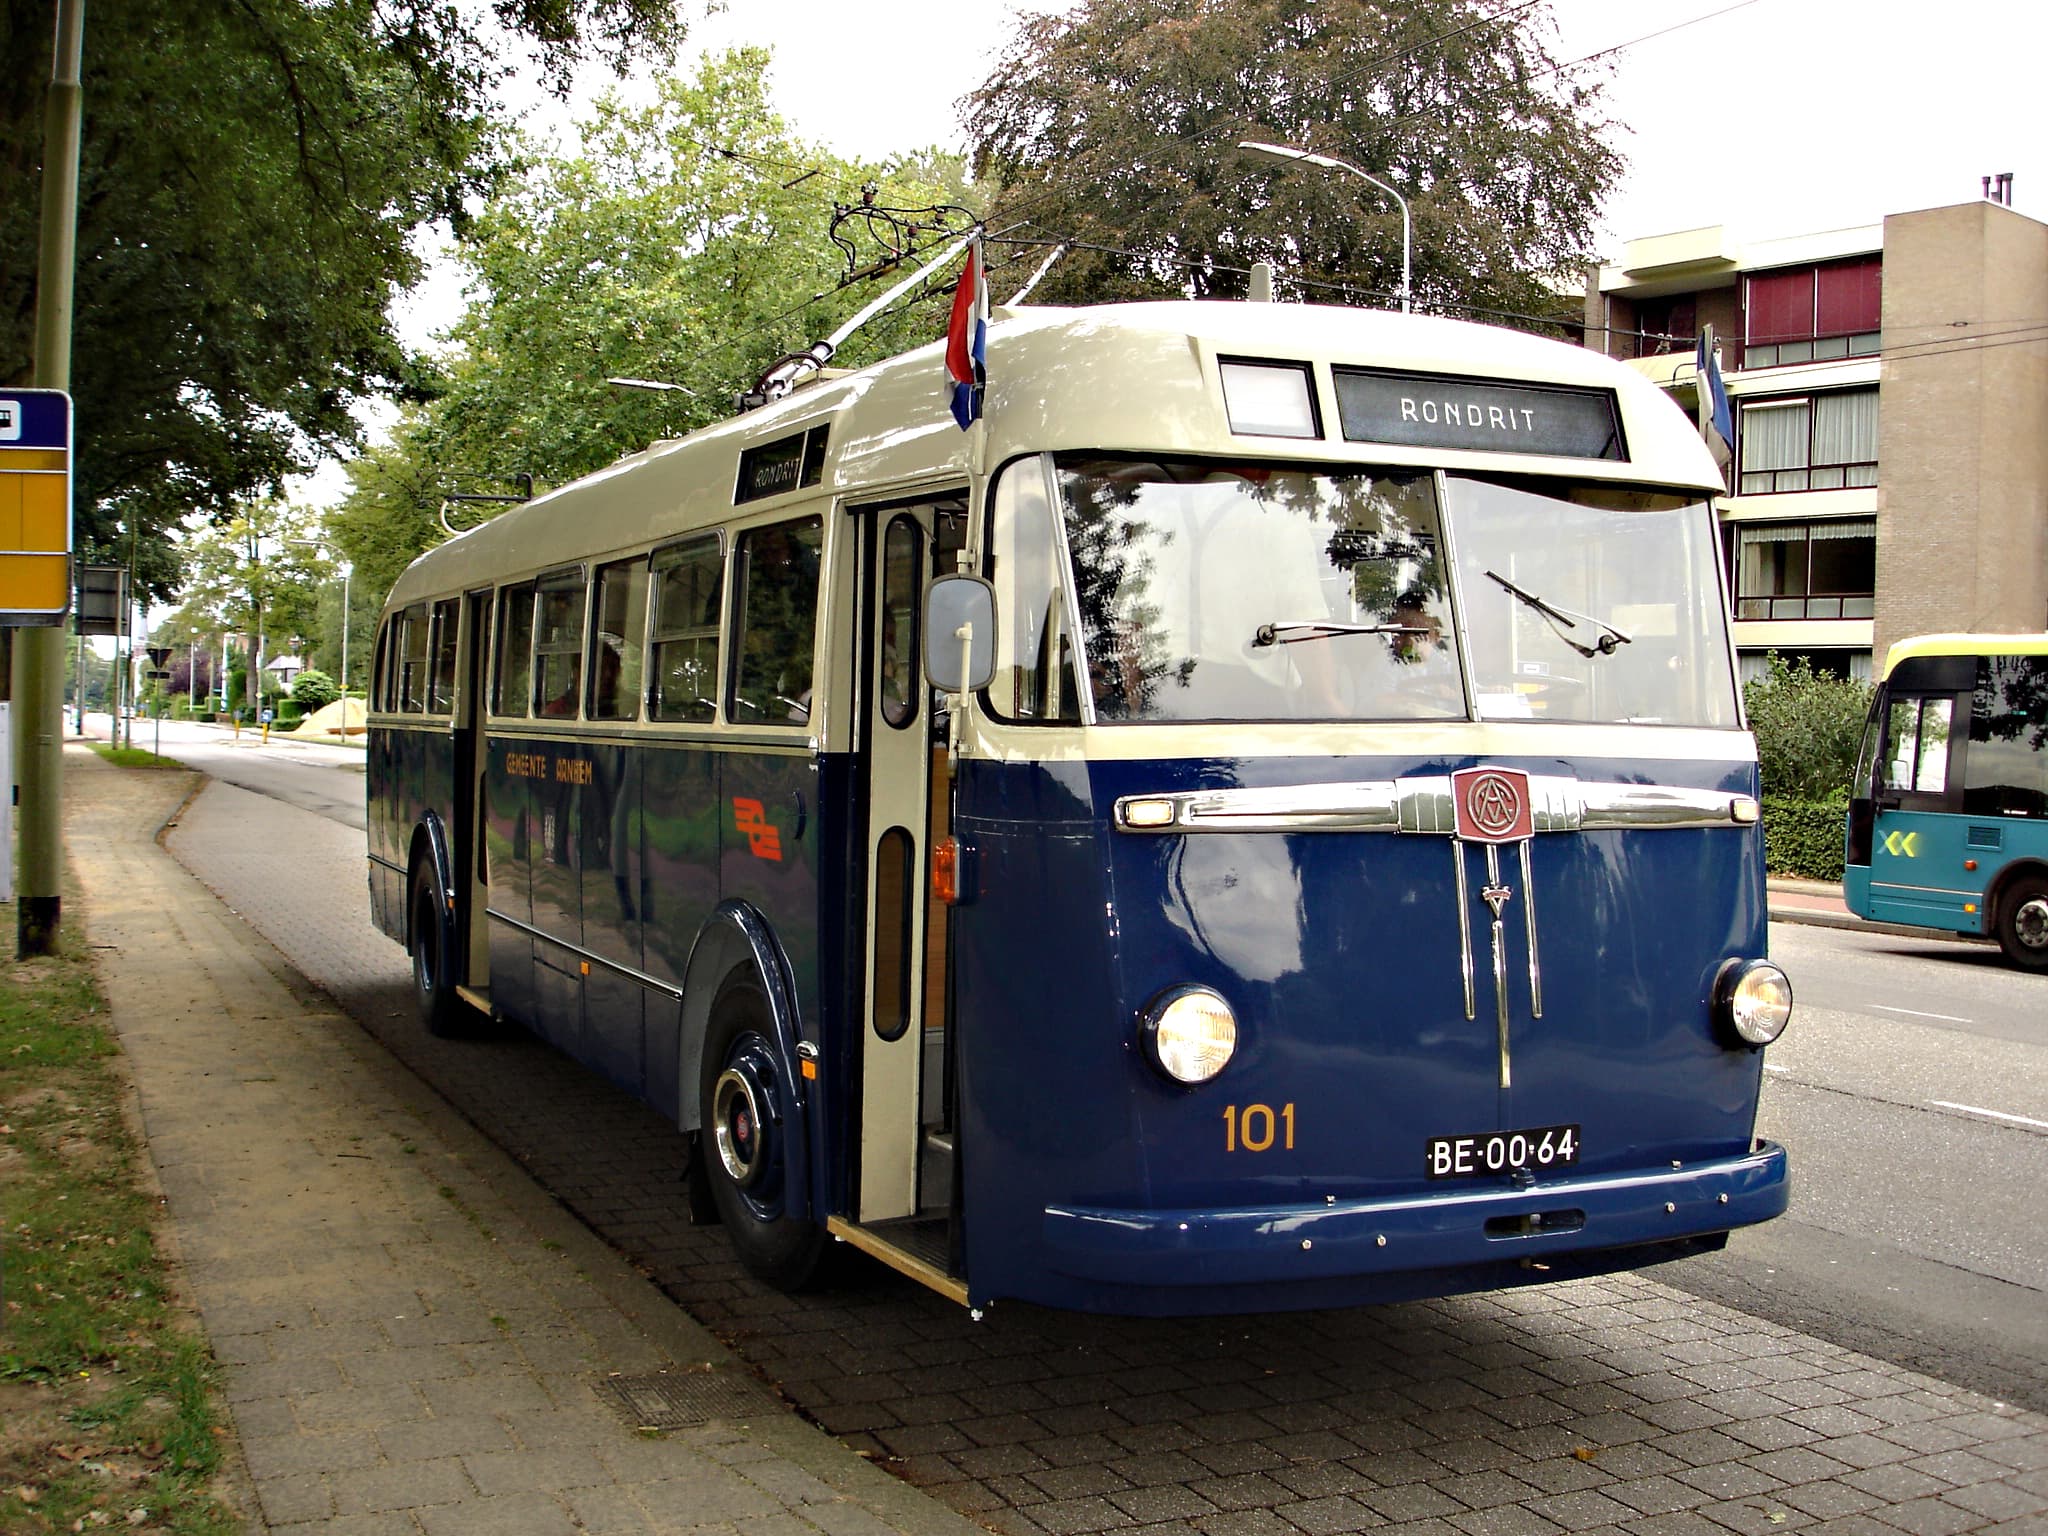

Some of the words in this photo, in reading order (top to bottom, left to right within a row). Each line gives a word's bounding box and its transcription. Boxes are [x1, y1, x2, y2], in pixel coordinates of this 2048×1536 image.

[1400, 397, 1534, 432] RONDRIT
[755, 458, 800, 489] RONDRIT
[506, 752, 546, 779] GEMEENTE
[556, 758, 592, 785] ARNHEM
[1223, 1103, 1294, 1152] 101
[1433, 1128, 1574, 1175] BE-00-64
